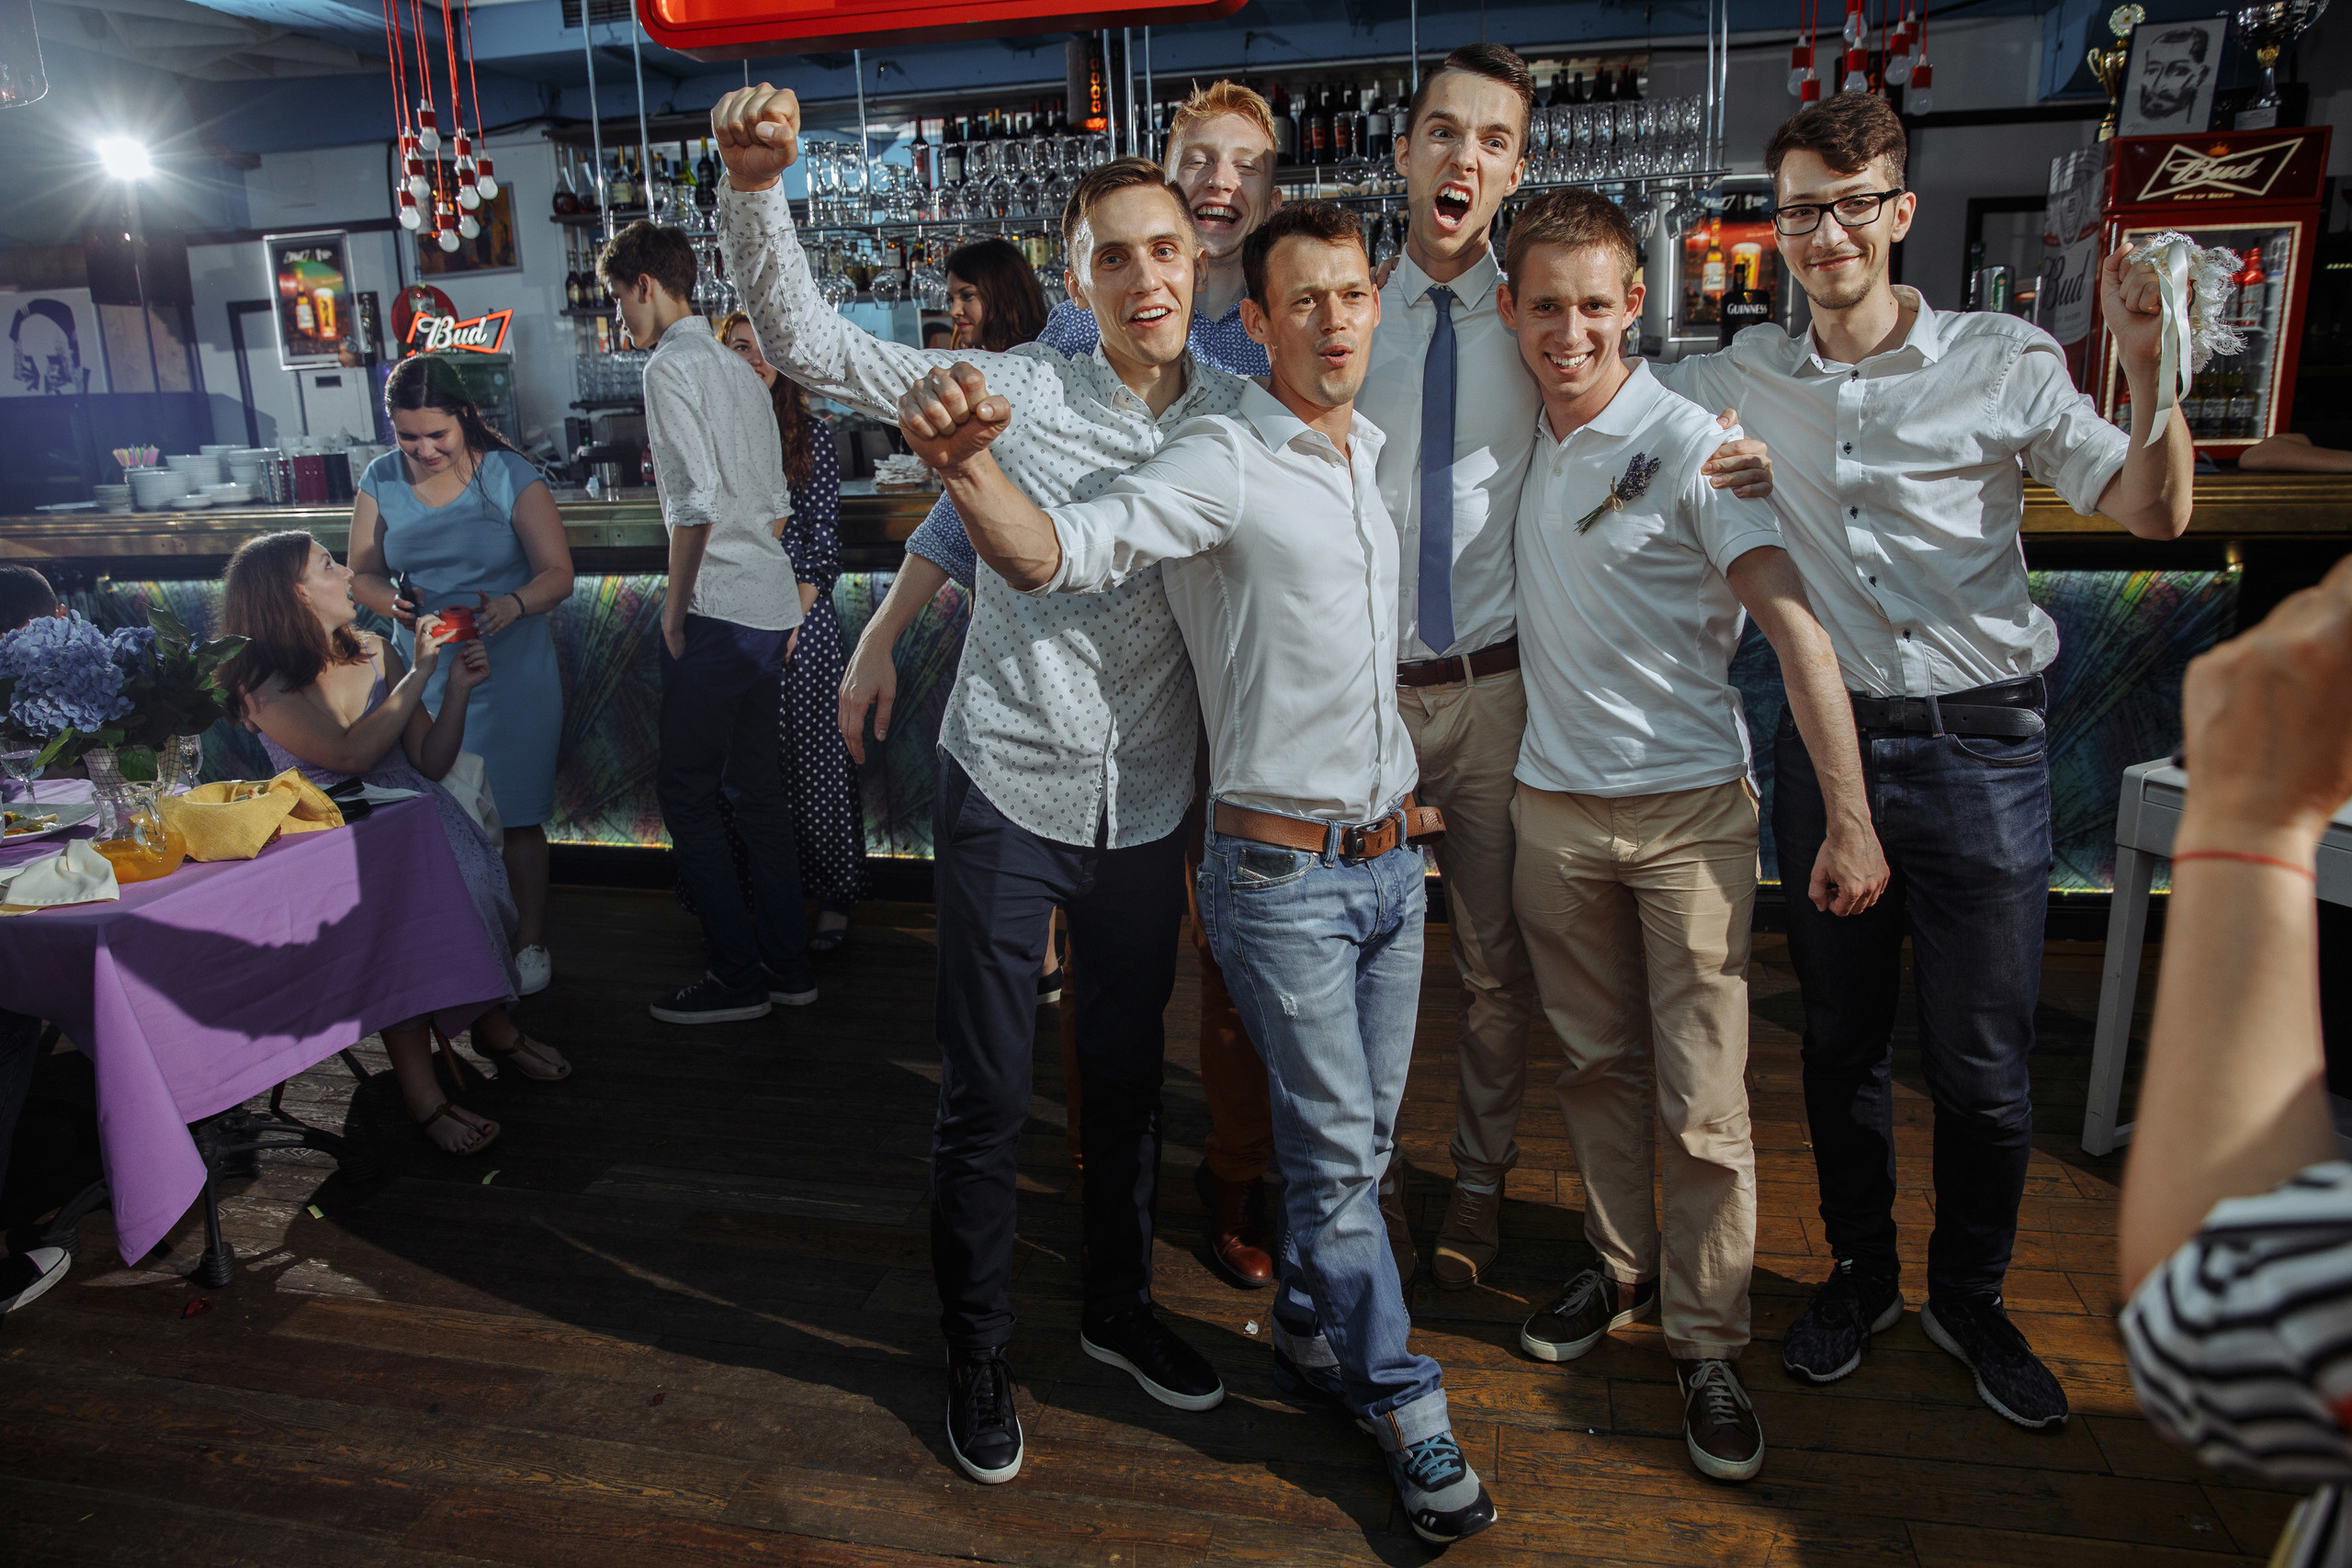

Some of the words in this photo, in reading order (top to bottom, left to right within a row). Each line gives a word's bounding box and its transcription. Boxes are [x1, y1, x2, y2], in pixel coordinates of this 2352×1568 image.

[2165, 156, 2266, 185] Bud
[2042, 248, 2091, 310] Bud
[1727, 302, 1768, 315] GUINNESS
[416, 314, 488, 349] Bud
